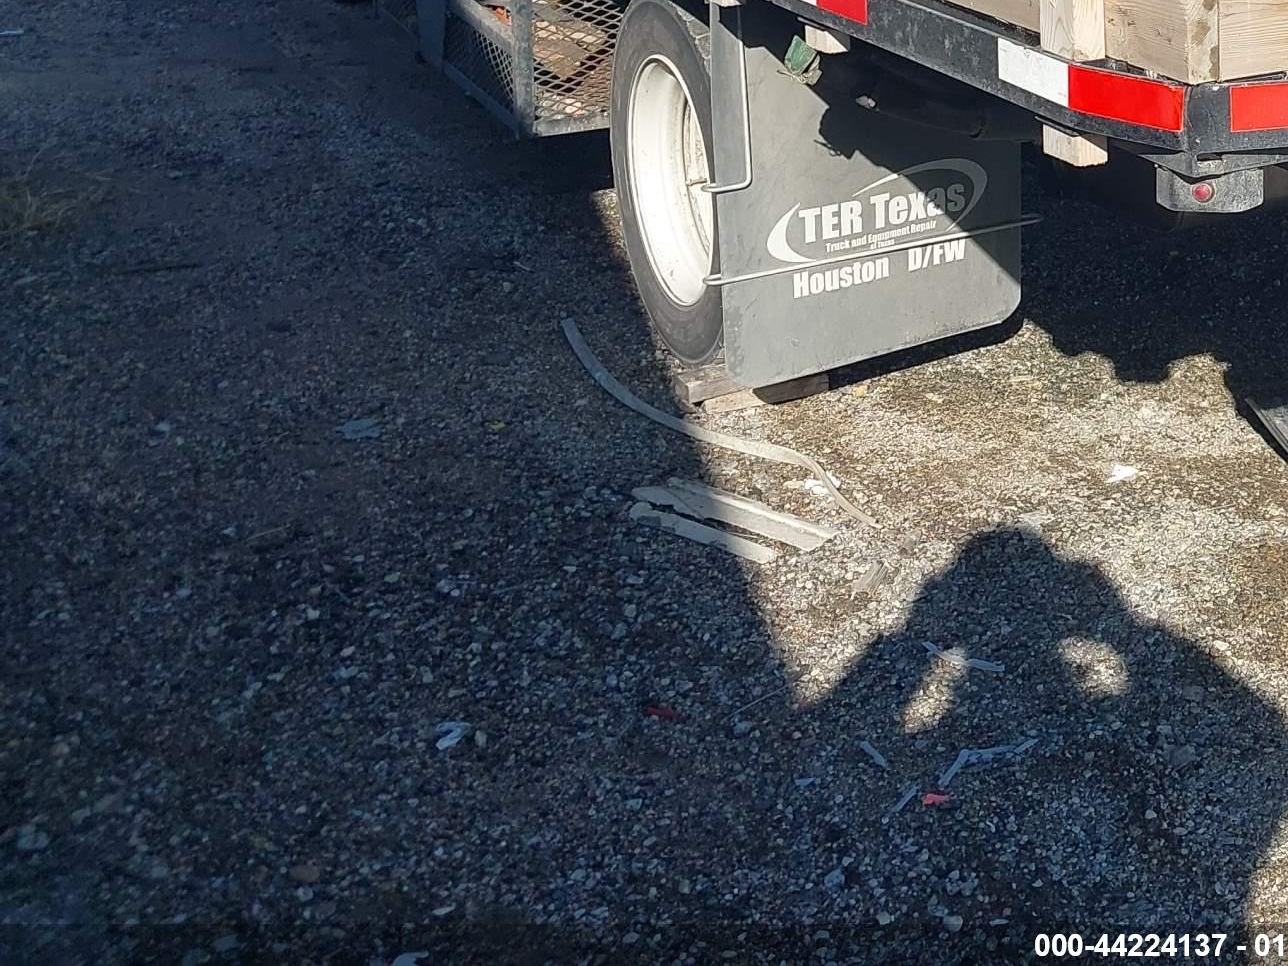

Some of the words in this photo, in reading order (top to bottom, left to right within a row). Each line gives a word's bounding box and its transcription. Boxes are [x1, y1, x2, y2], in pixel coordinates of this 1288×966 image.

[798, 199, 863, 244] TER
[870, 184, 966, 229] Texas
[825, 238, 851, 253] Truck
[851, 236, 867, 247] and
[868, 227, 909, 244] Equipment
[910, 220, 937, 234] Repair
[793, 256, 890, 298] Houston
[907, 238, 967, 272] D/FW
